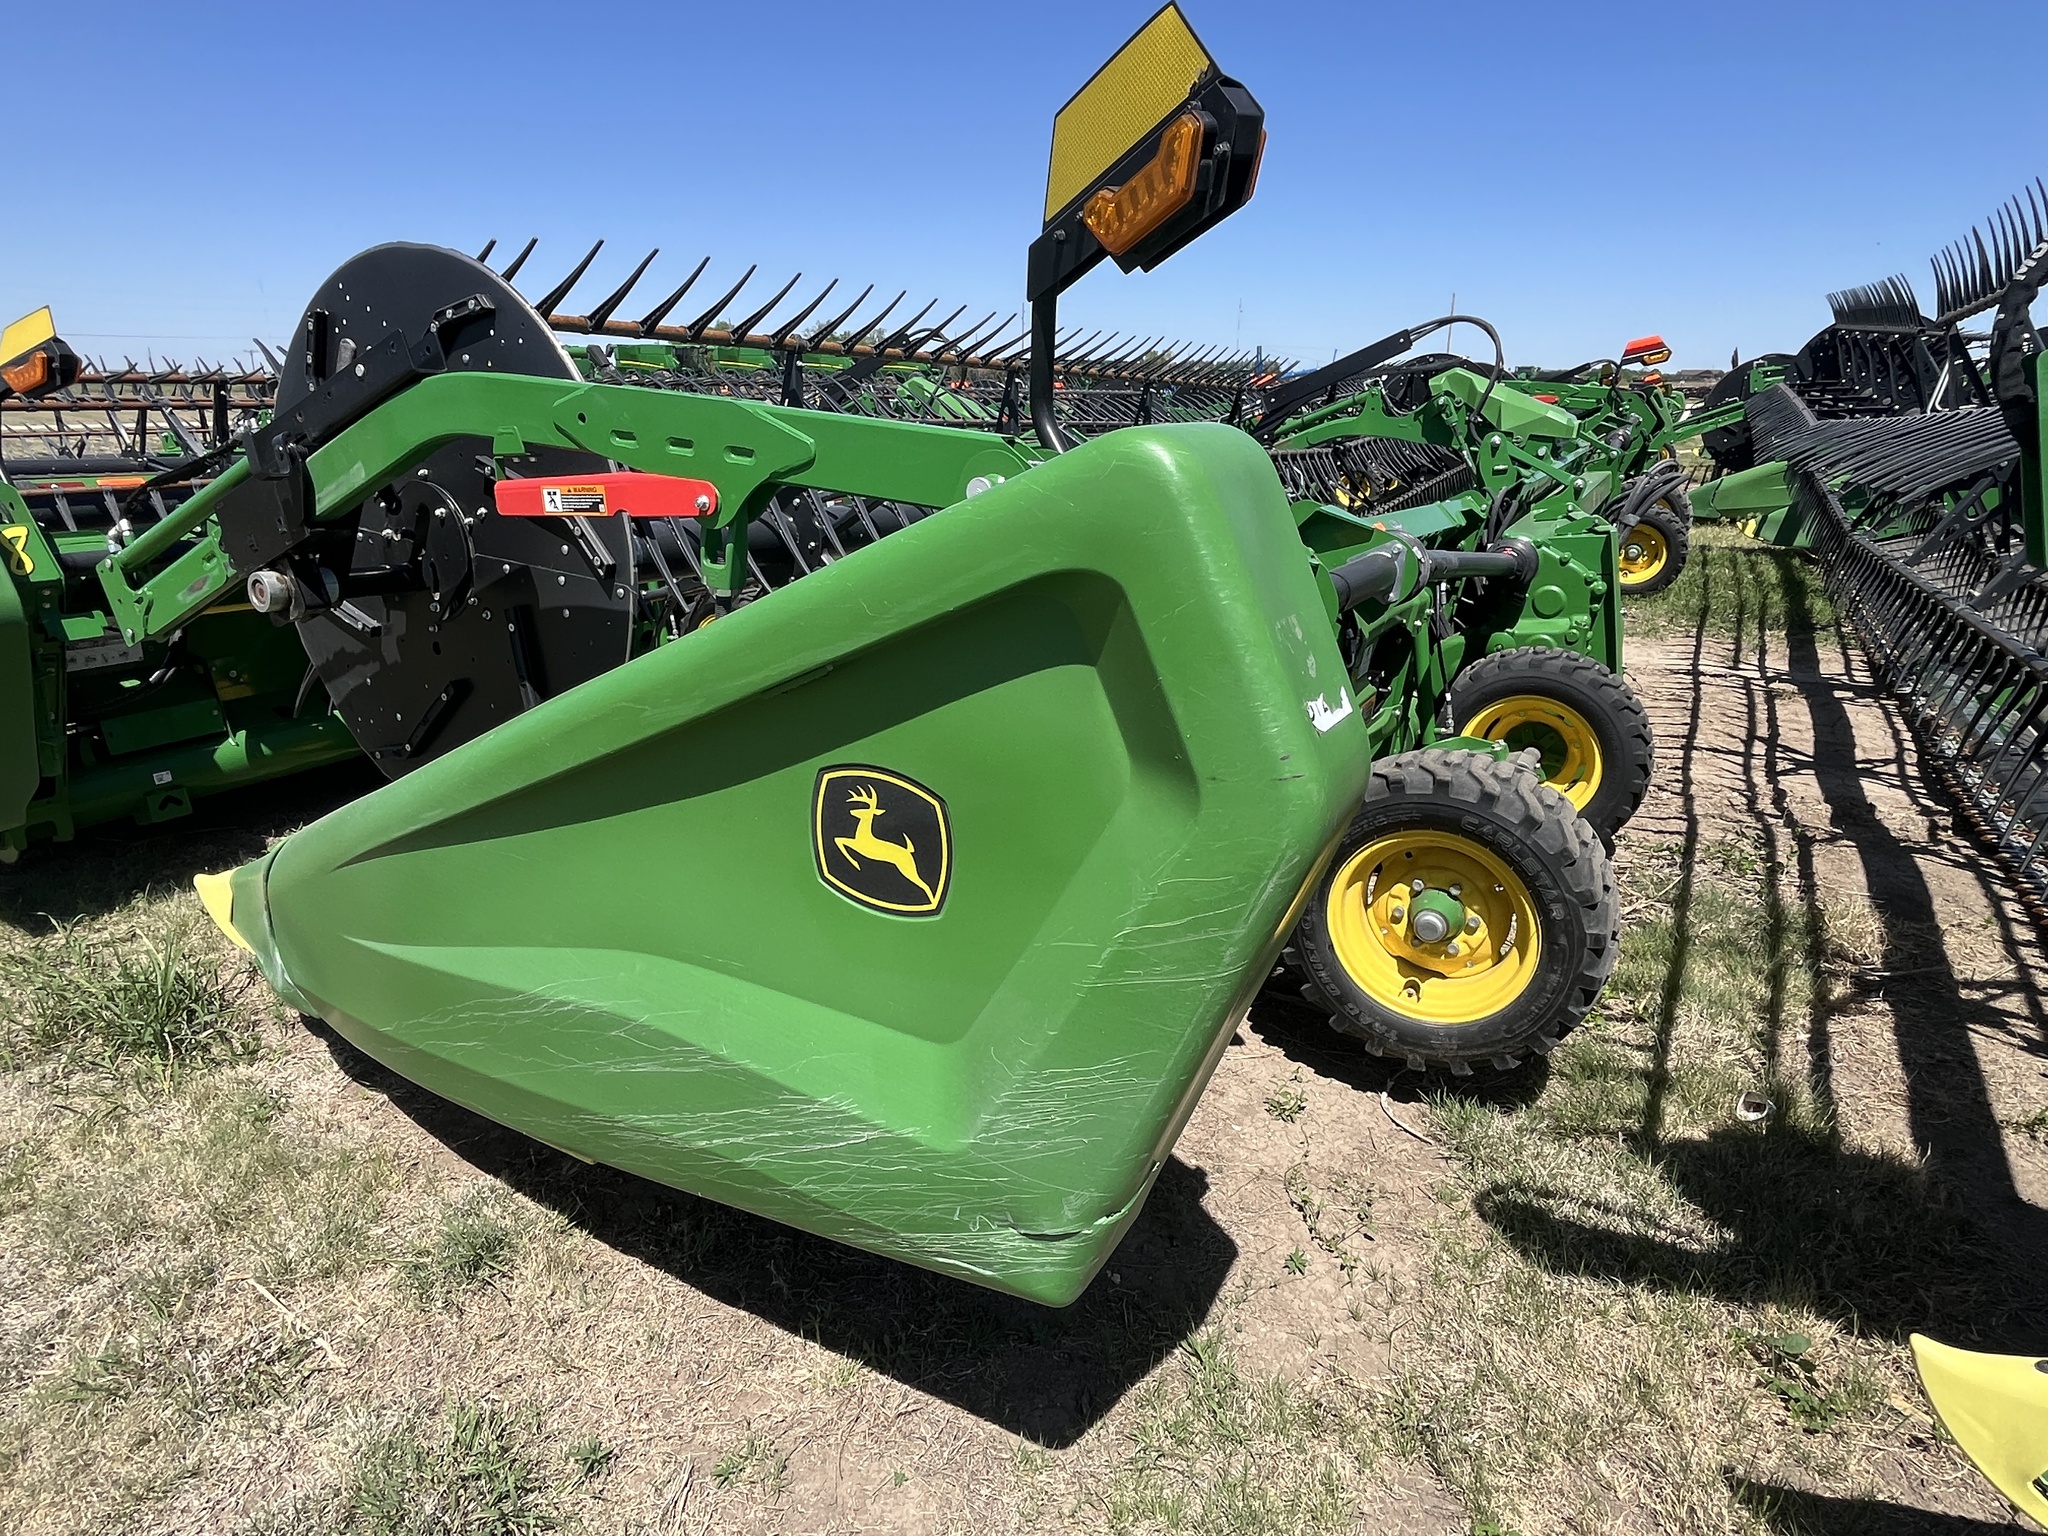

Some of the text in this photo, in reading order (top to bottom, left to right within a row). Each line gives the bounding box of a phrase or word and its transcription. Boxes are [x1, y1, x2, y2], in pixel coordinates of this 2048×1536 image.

[1460, 815, 1565, 921] CARLSTAR
[1302, 936, 1398, 1041] TRAC CHIEF
